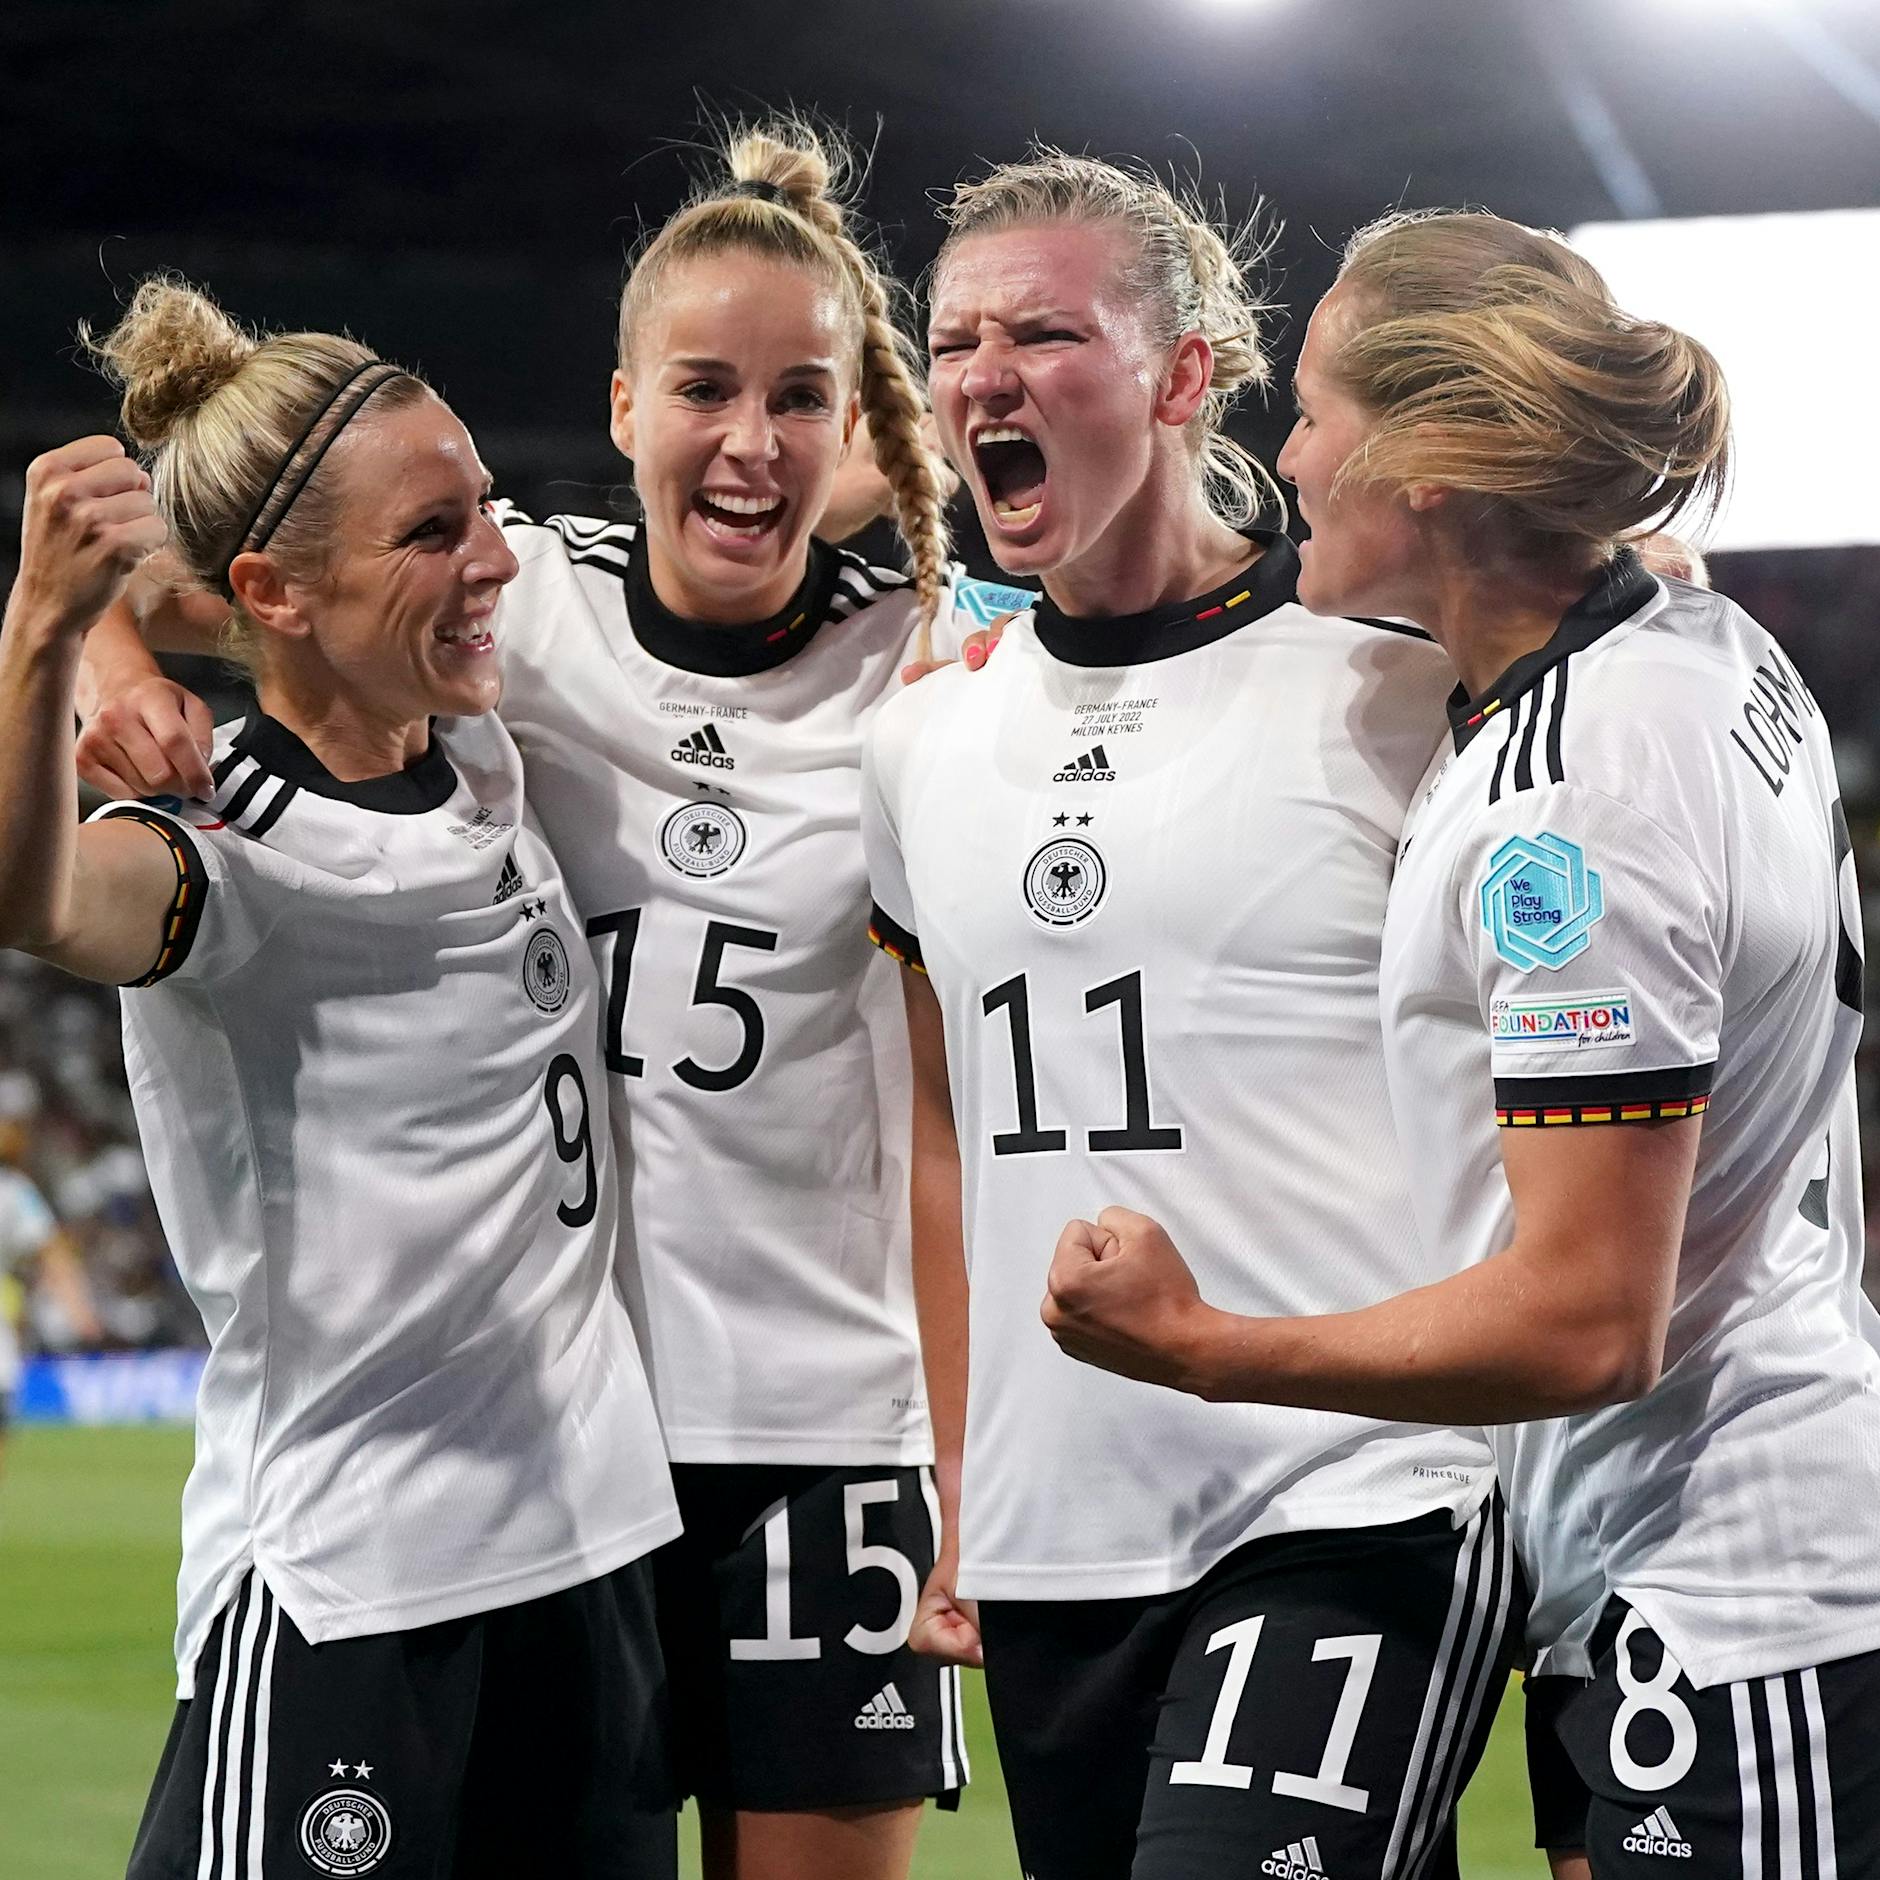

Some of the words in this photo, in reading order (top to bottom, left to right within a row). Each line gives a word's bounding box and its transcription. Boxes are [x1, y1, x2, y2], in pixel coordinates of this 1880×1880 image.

[659, 702, 748, 719] GERMANY-FRANCE
[1074, 697, 1159, 715] GERMANY-FRANCE
[1081, 715, 1094, 725] 27
[1095, 713, 1118, 725] JULY
[1119, 711, 1142, 723] 2022
[1070, 725, 1106, 737] MILTON
[1107, 722, 1144, 735] KEYNES
[671, 747, 735, 770] adidas
[1052, 768, 1116, 782] adidas
[683, 809, 731, 827] DEUTSCHER
[1042, 848, 1089, 865] DEUTSCHER
[1510, 879, 1531, 891] We
[1036, 889, 1093, 914] FUSSBALL-BUND
[1511, 894, 1543, 910] Play
[1512, 909, 1562, 924] Strong
[585, 906, 779, 1092] 15
[1492, 1000, 1509, 1012] EFA
[1578, 1033, 1592, 1048] for
[1594, 1031, 1631, 1043] children
[980, 967, 1184, 1158] 11
[544, 1053, 598, 1228] 9
[1412, 1466, 1470, 1484] PRIMEBLUE
[730, 1478, 919, 1661] 15
[1610, 1607, 1698, 1791] 8
[854, 1710, 915, 1729] adidas
[1169, 1614, 1383, 1814] 11
[322, 1800, 374, 1818] DEUTSCHER
[315, 1838, 376, 1864] FUSSBALL-BUND
[1623, 1834, 1693, 1858] adidas
[1261, 1860, 1330, 1880] adid
